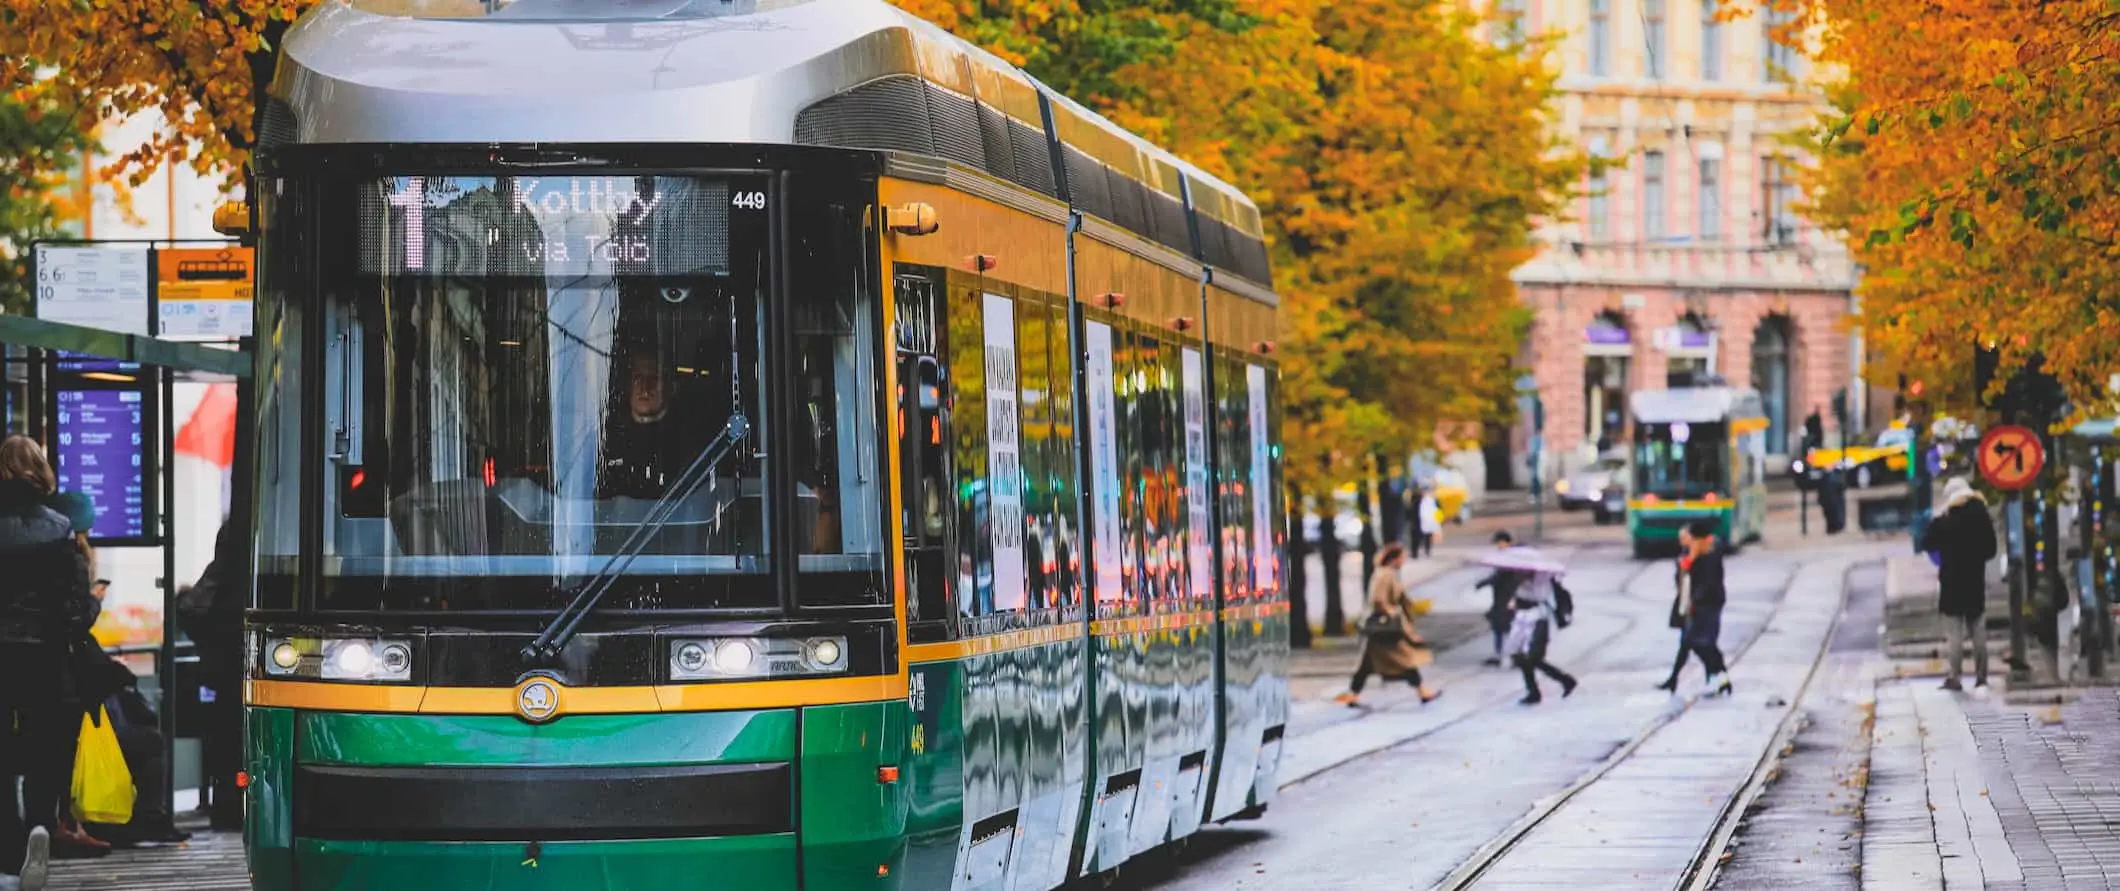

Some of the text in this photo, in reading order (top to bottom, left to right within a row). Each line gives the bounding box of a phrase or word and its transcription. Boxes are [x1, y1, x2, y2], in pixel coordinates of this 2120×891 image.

[512, 177, 662, 225] Kottby
[731, 191, 766, 210] 449
[390, 176, 423, 268] 1
[40, 250, 47, 264] 3
[523, 234, 651, 263] via Tölö
[40, 286, 54, 300] 10
[58, 432, 72, 446] 10
[911, 723, 924, 756] 449
